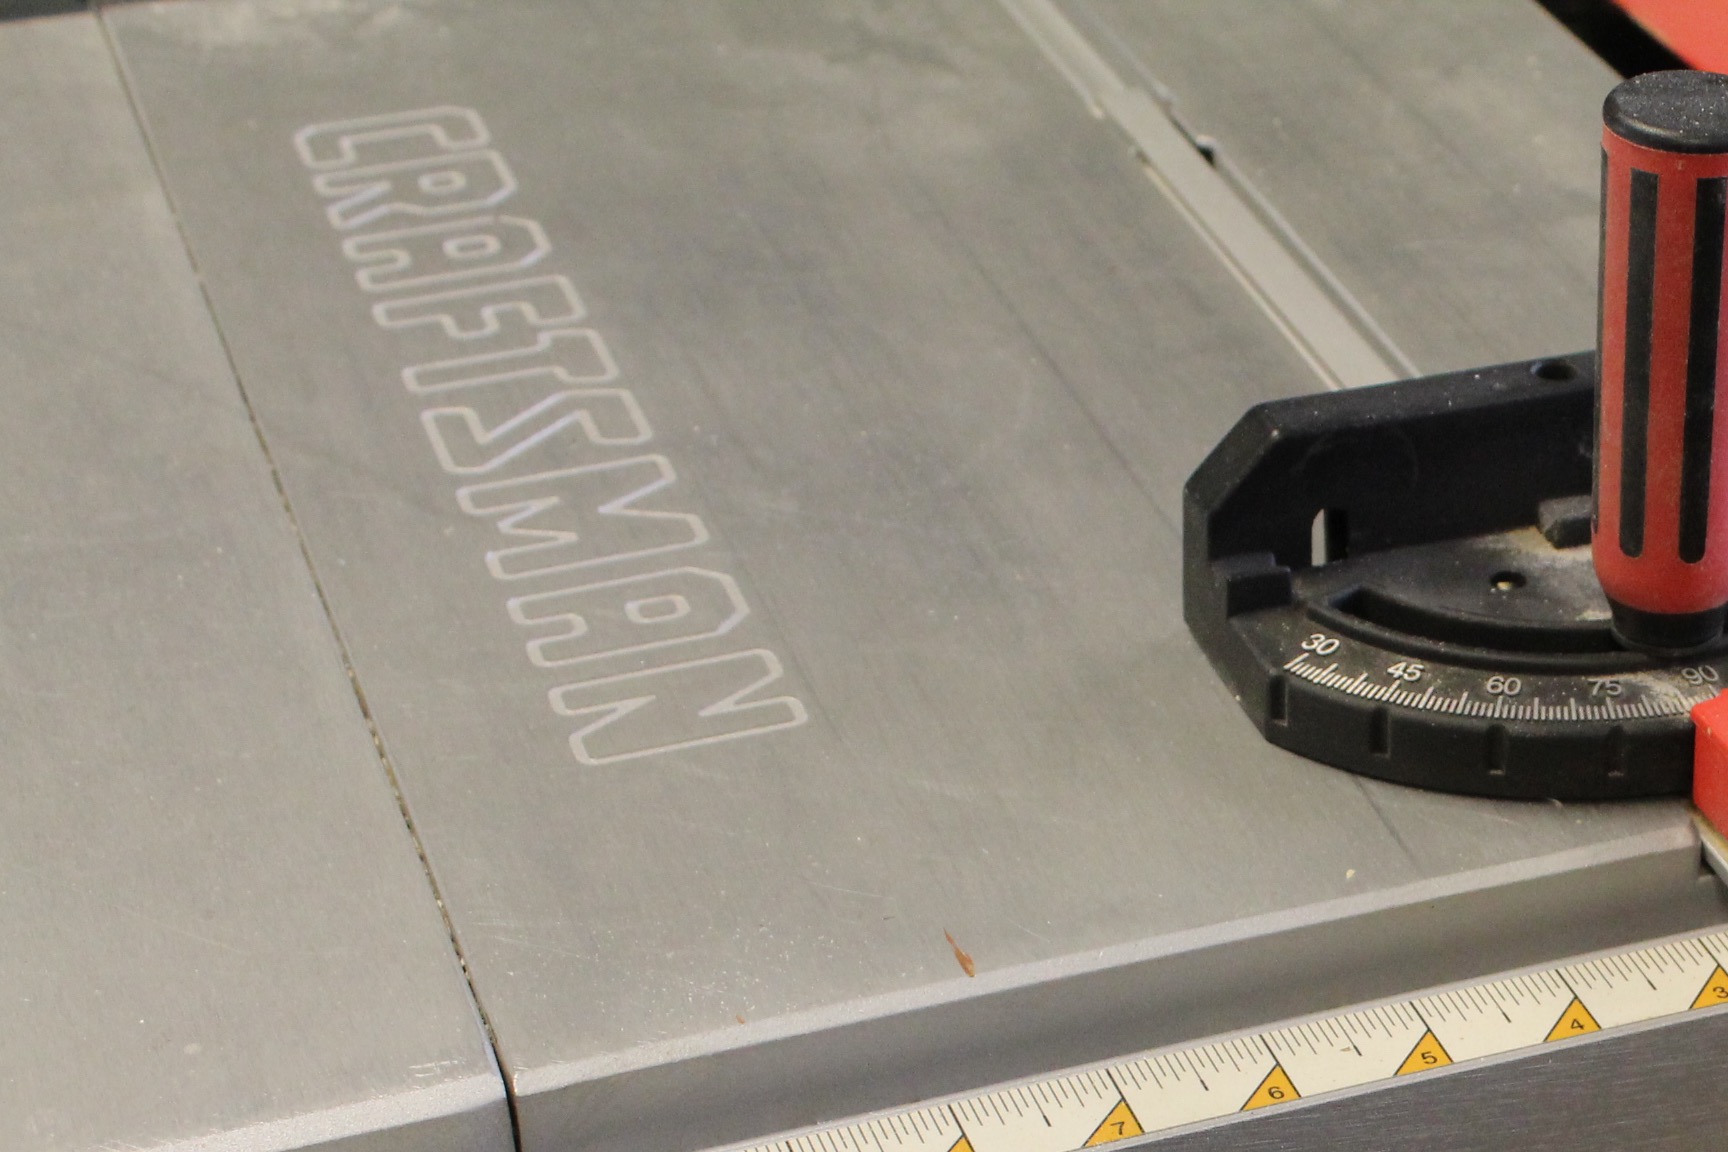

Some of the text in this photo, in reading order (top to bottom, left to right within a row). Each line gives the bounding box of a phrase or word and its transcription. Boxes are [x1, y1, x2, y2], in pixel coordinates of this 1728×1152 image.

[293, 104, 808, 765] CRAFTSMAN
[1301, 633, 1340, 656] 30
[1387, 661, 1425, 682] 45
[1681, 665, 1720, 685] 90
[1486, 675, 1522, 696] 60
[1587, 678, 1623, 696] 75
[1569, 1018, 1585, 1034] 4
[1421, 1050, 1438, 1066] 5
[1267, 1085, 1286, 1101] 6
[1110, 1121, 1126, 1137] 7
